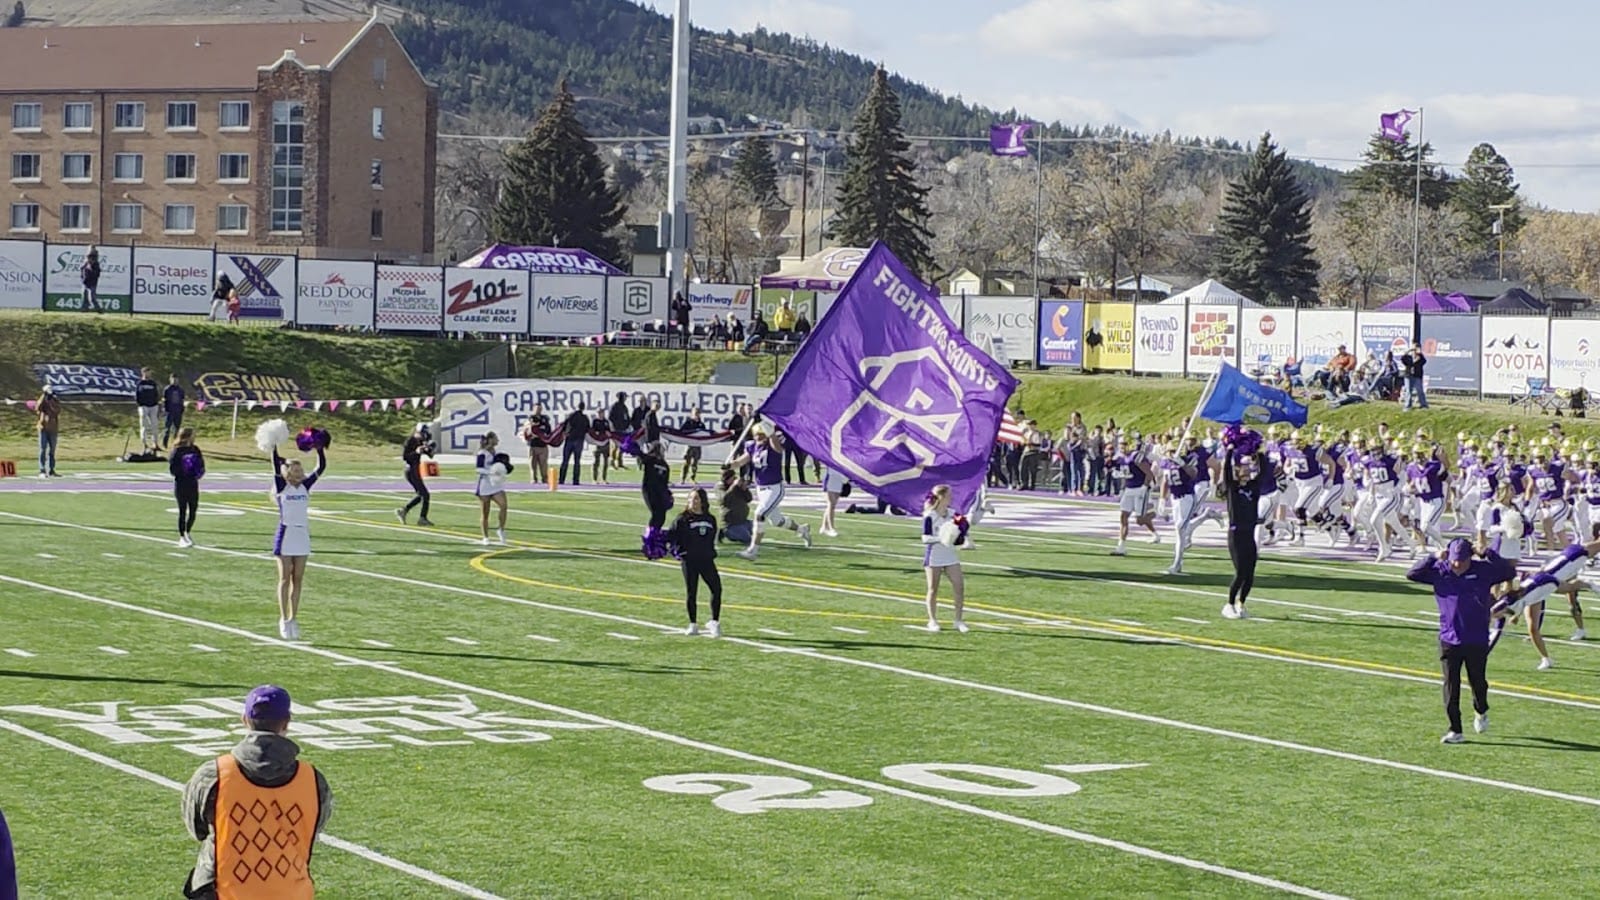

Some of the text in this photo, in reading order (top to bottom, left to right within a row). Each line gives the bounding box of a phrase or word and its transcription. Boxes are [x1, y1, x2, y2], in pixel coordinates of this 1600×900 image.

[491, 251, 608, 273] CARROLL
[158, 265, 208, 279] Staples
[236, 256, 272, 295] VALLEY
[135, 279, 207, 296] Business
[300, 285, 373, 299] RED DOG
[689, 293, 733, 305] Thriftway
[453, 315, 490, 323] CLASSIC
[1140, 316, 1178, 331] REWIND
[1107, 330, 1131, 343] WILD
[1362, 327, 1409, 338] HARRINGTON
[1042, 336, 1078, 350] Comfort
[1107, 344, 1131, 353] WINGS
[1484, 353, 1545, 370] TOYOTA
[46, 364, 140, 379] PLACER
[241, 374, 300, 391] SAINTS
[504, 390, 747, 414] CARROLL COLLEGE
[172, 730, 553, 756] FELD
